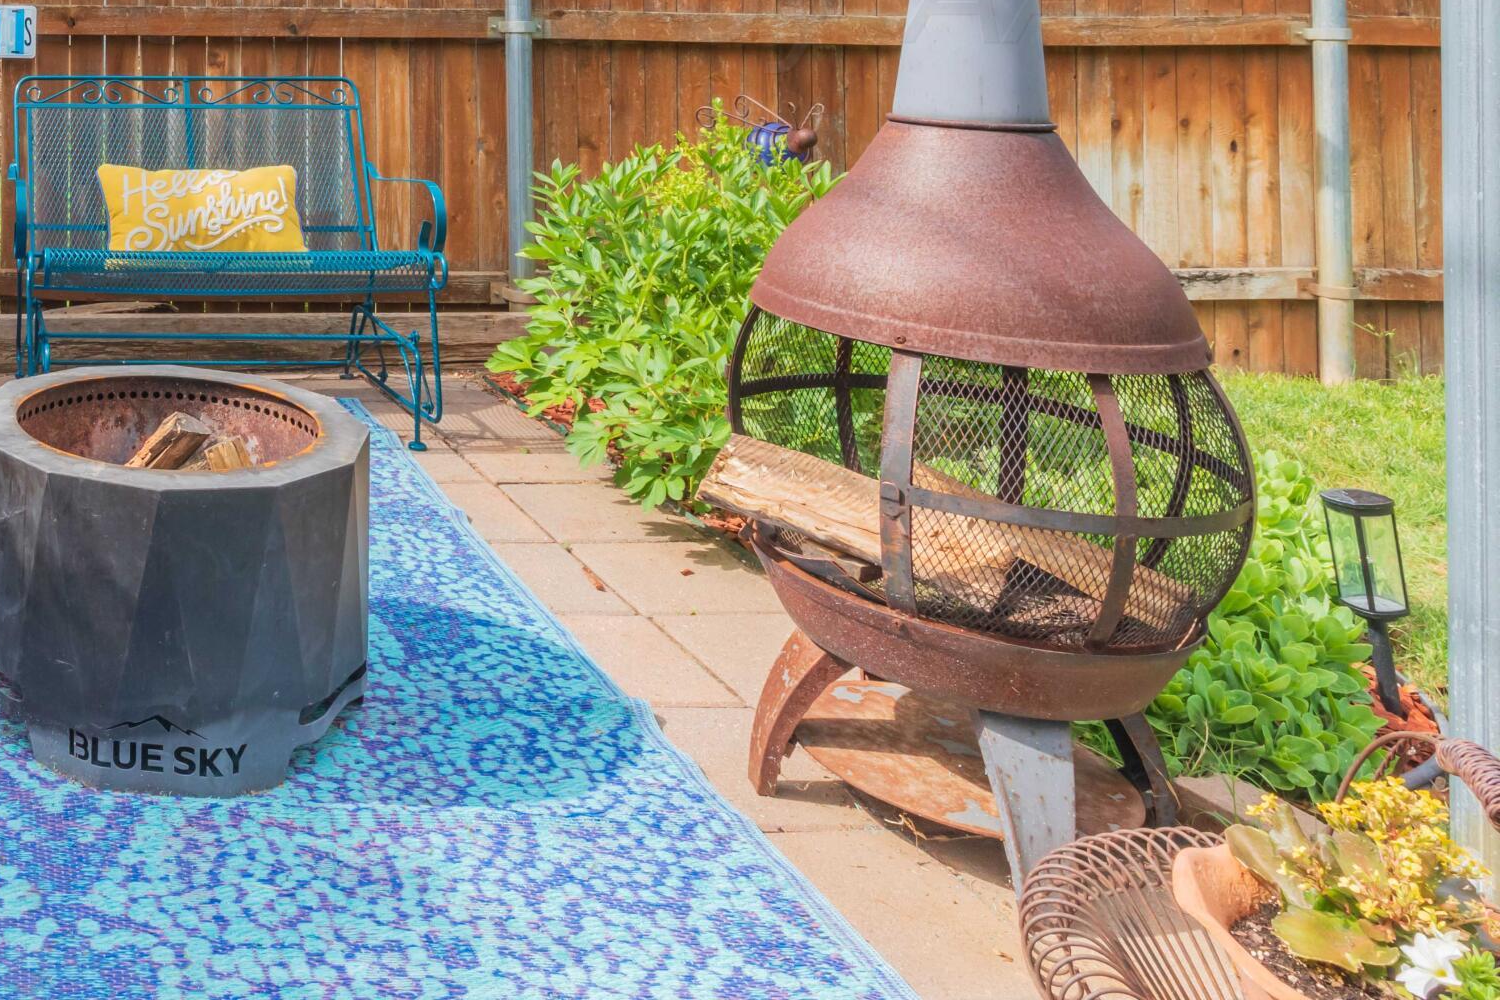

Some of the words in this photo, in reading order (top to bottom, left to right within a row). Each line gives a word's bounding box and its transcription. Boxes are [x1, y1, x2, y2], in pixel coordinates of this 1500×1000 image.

[125, 176, 289, 251] Sunshine!
[68, 728, 164, 773] BLUE
[173, 744, 248, 777] SKY
